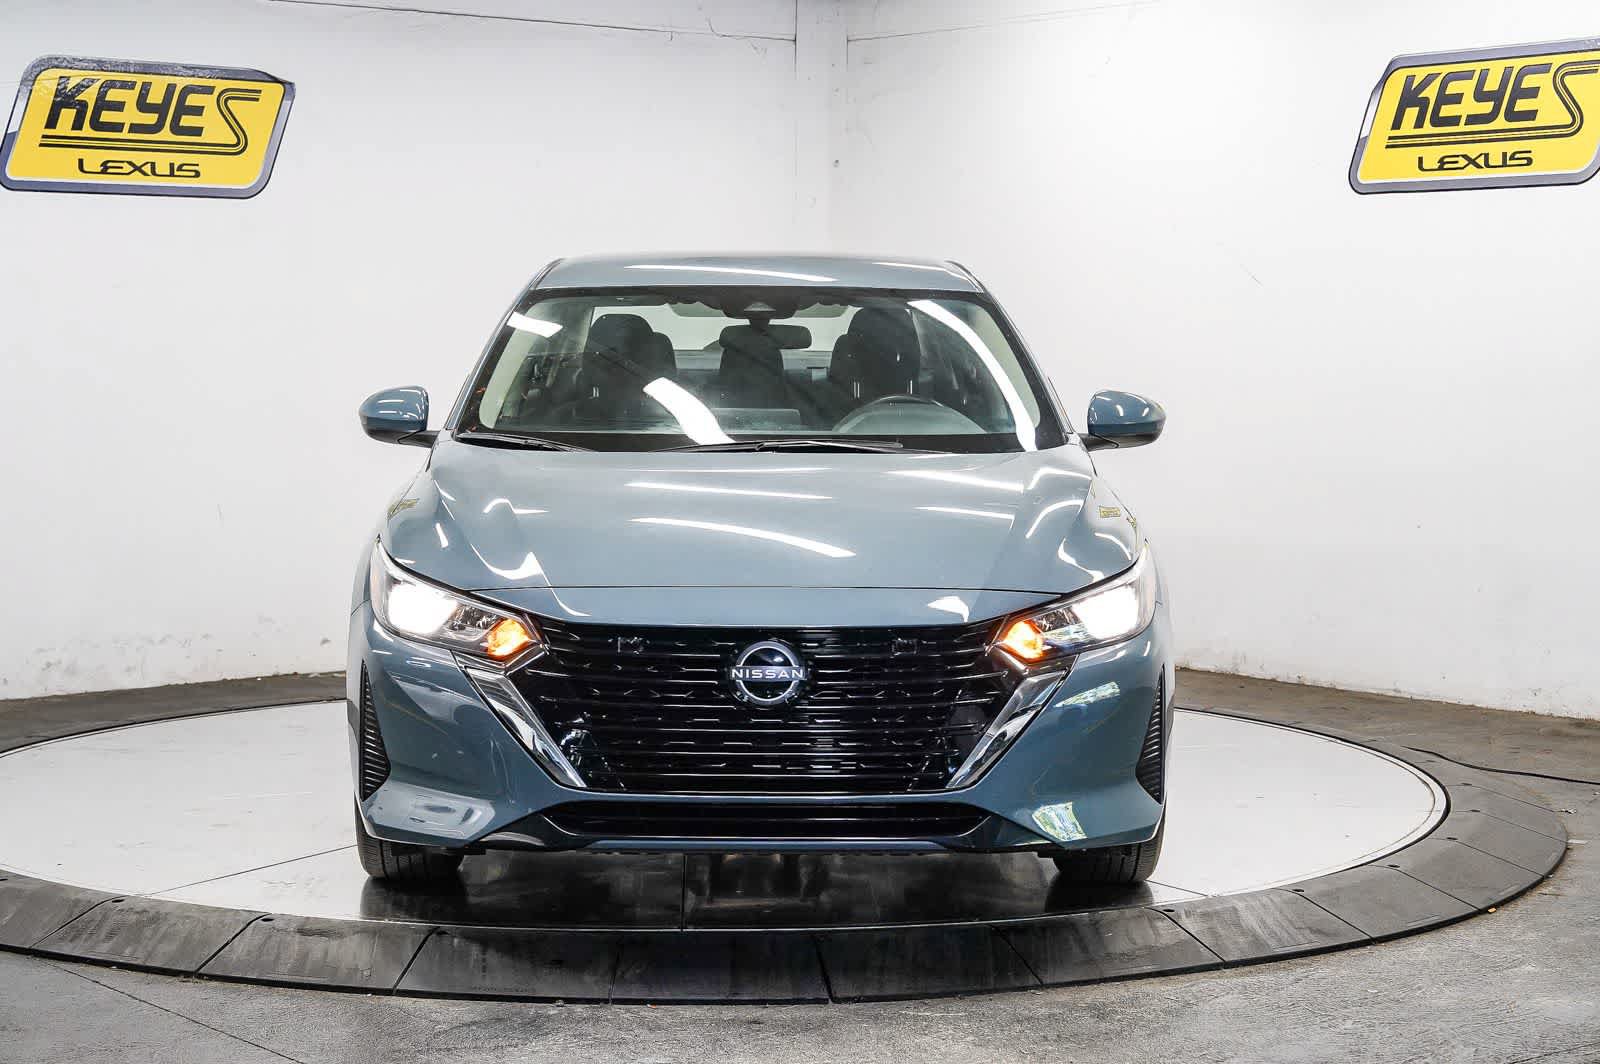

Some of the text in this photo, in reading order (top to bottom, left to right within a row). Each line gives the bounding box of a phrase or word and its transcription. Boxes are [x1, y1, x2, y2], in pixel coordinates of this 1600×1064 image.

[39, 76, 262, 155] KEYES
[1385, 60, 1600, 149] KEYES
[78, 158, 201, 178] LEXUS
[1417, 150, 1533, 172] LEXUS
[731, 669, 803, 679] NISSAN
